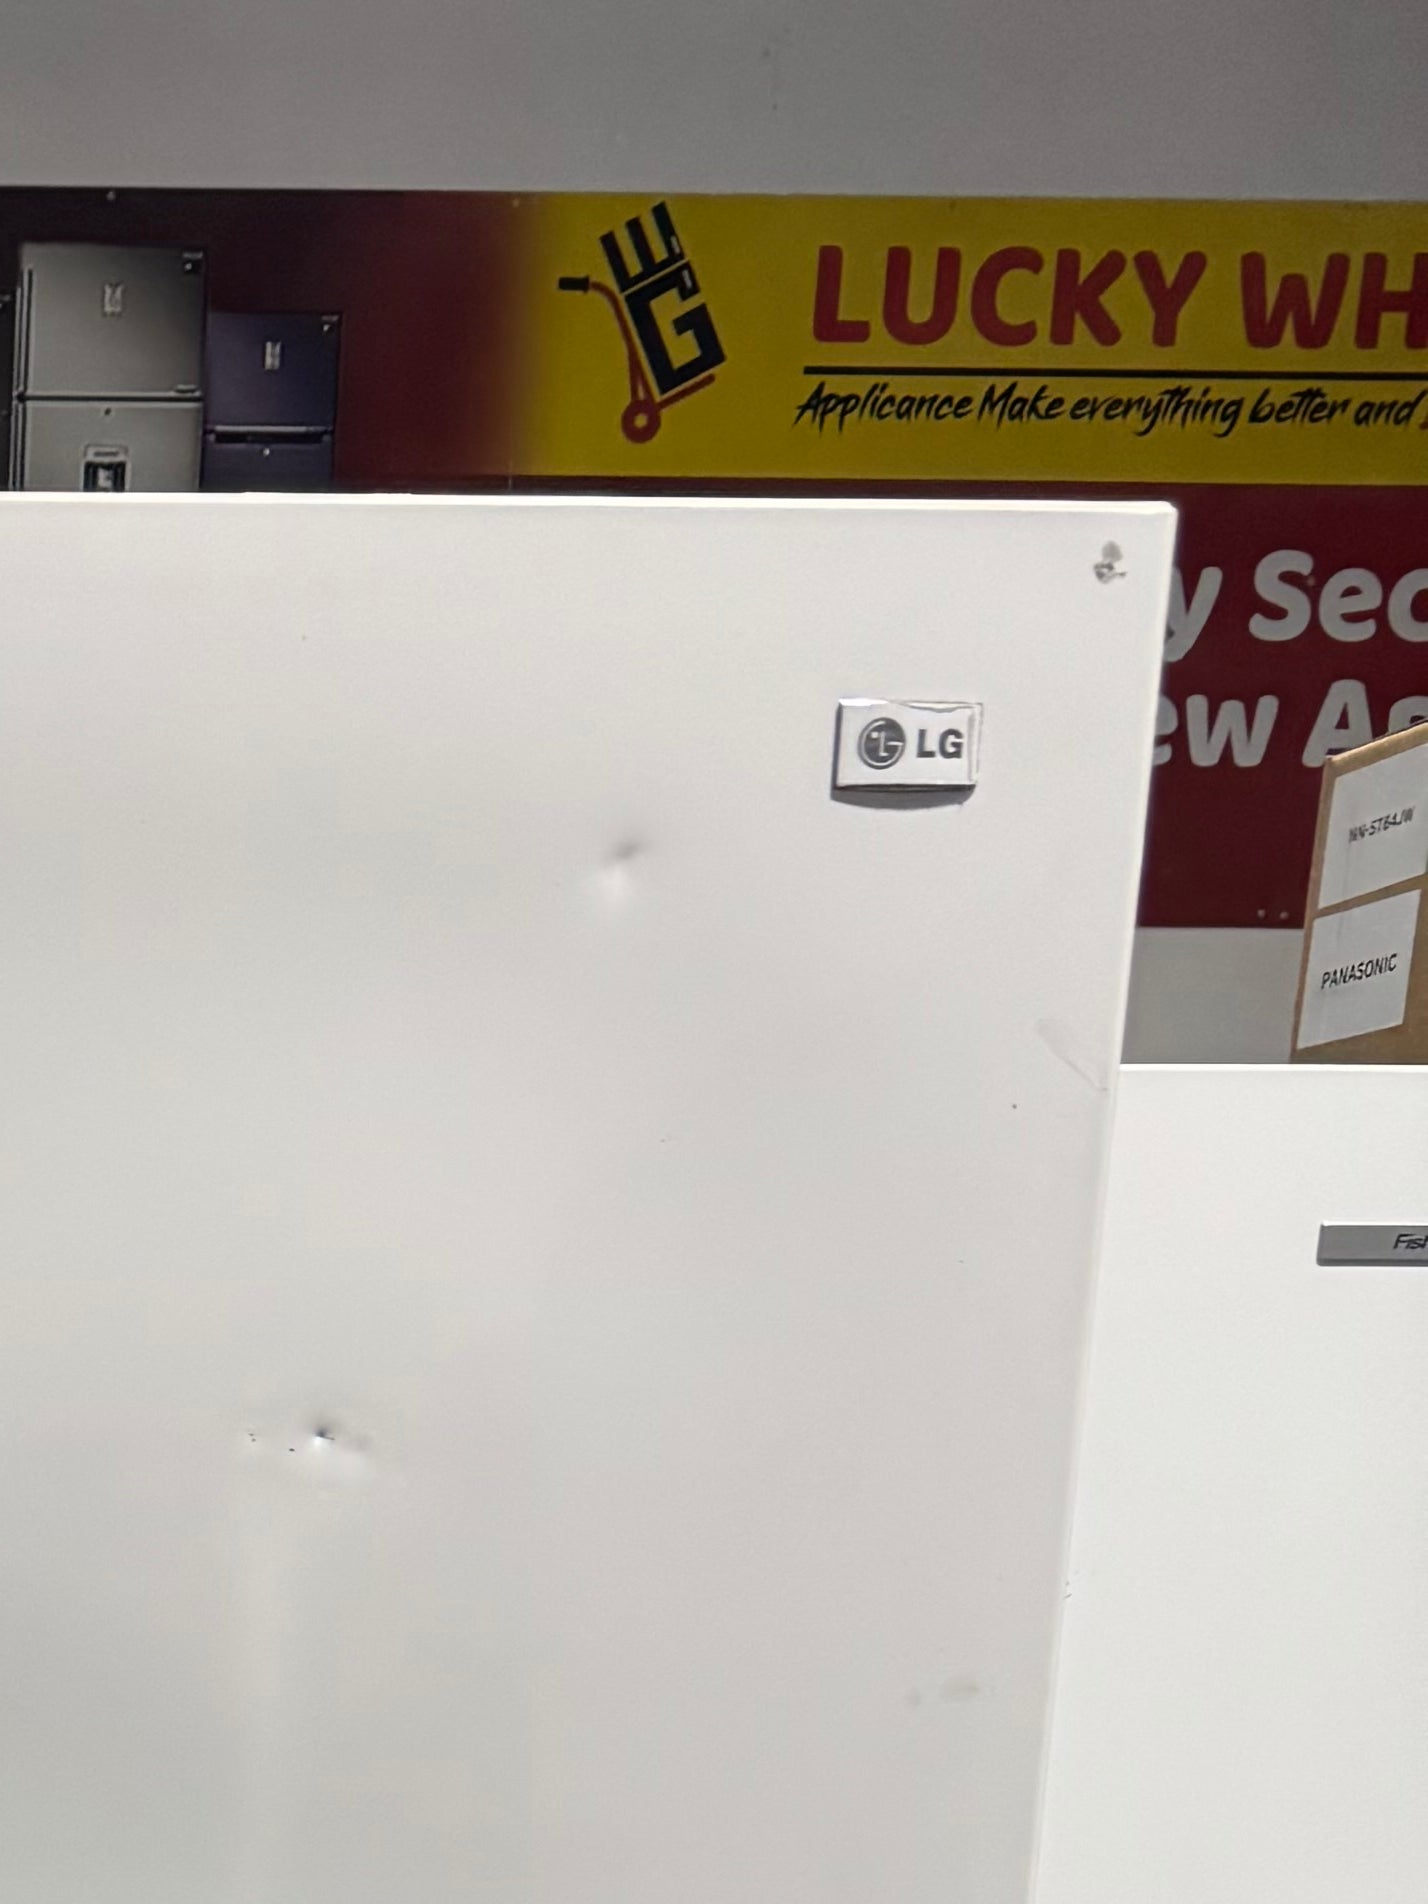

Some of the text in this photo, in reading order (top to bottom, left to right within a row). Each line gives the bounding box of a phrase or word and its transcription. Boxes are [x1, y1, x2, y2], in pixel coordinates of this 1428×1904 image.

[813, 245, 1428, 350] LUCKY WH
[794, 381, 1423, 437] Applicance Make everything better and
[916, 728, 964, 760] LG
[1321, 954, 1398, 990] PANASONIC
